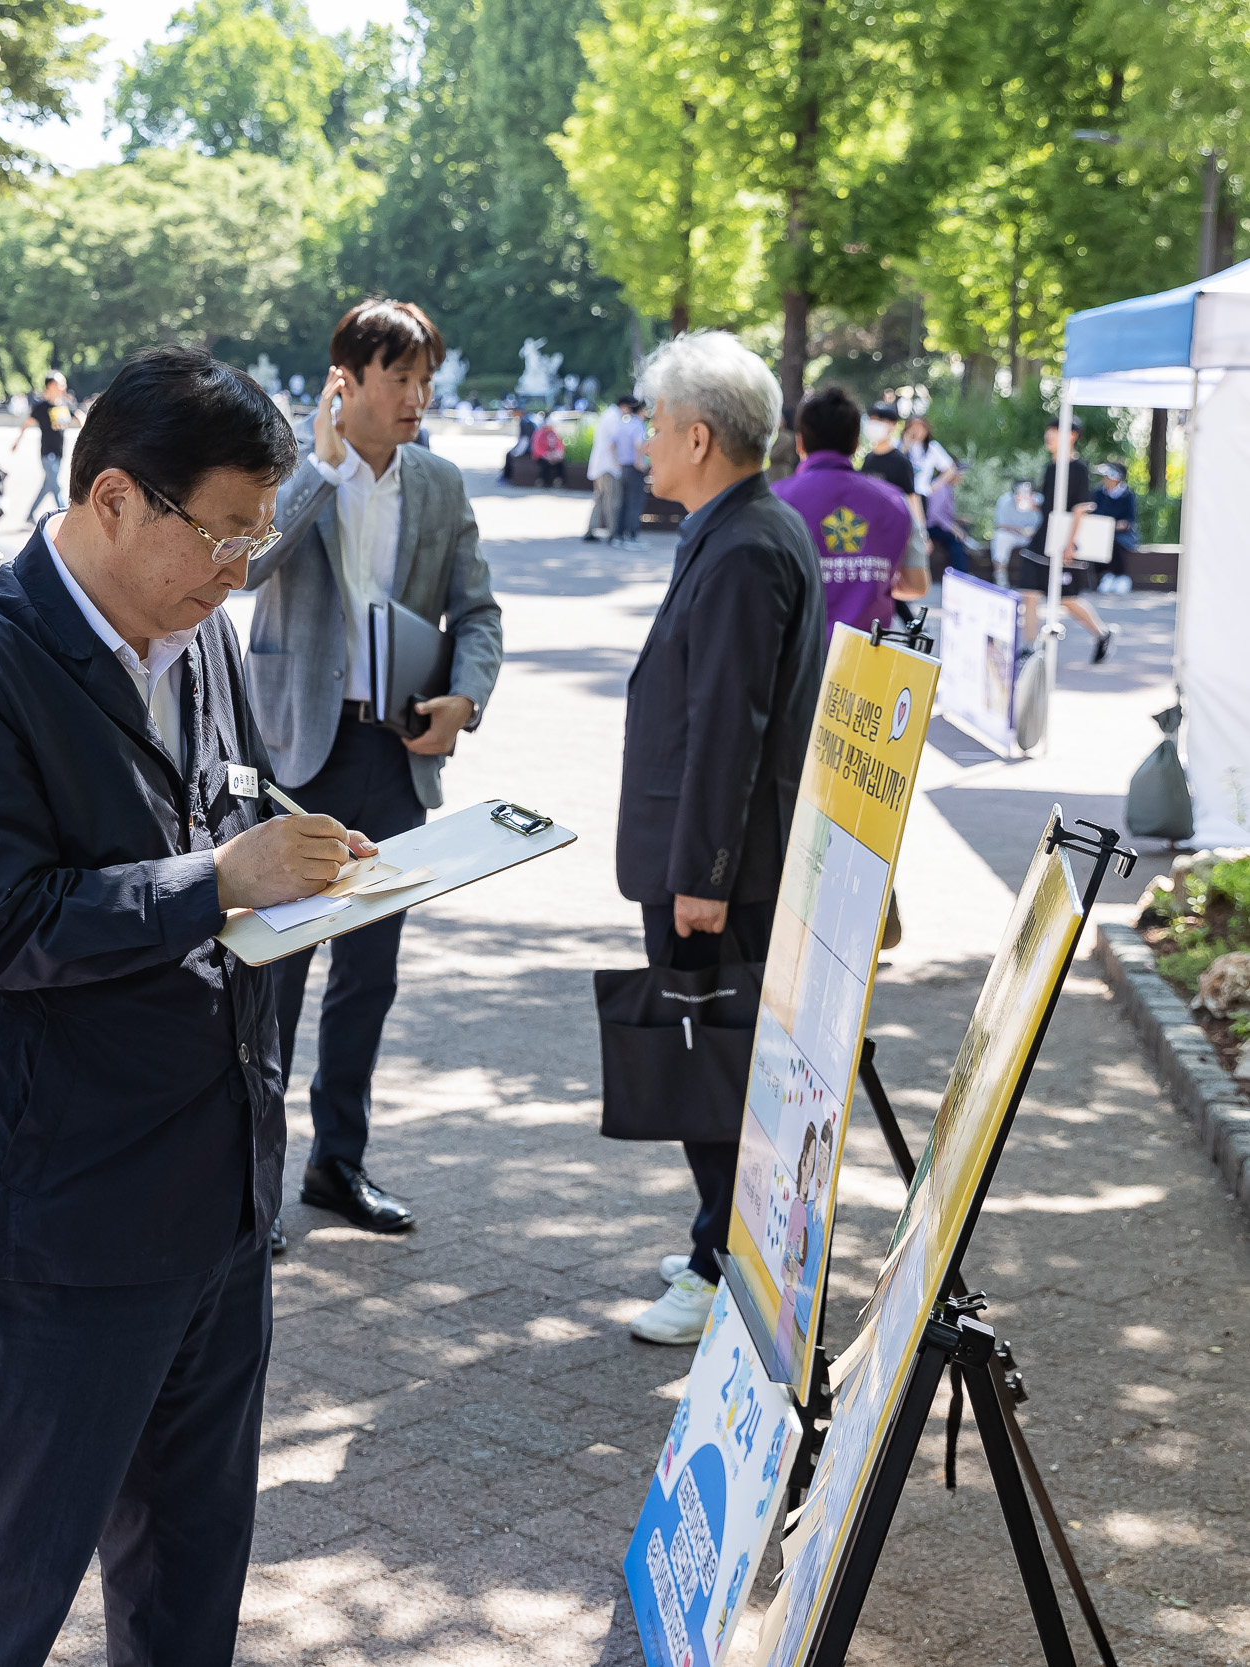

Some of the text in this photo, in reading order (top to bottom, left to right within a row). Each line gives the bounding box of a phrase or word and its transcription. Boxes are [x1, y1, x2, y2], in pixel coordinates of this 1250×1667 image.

[823, 681, 883, 743] 저출산의 원인을
[814, 725, 906, 812] 무엇이라 생각하십니까?
